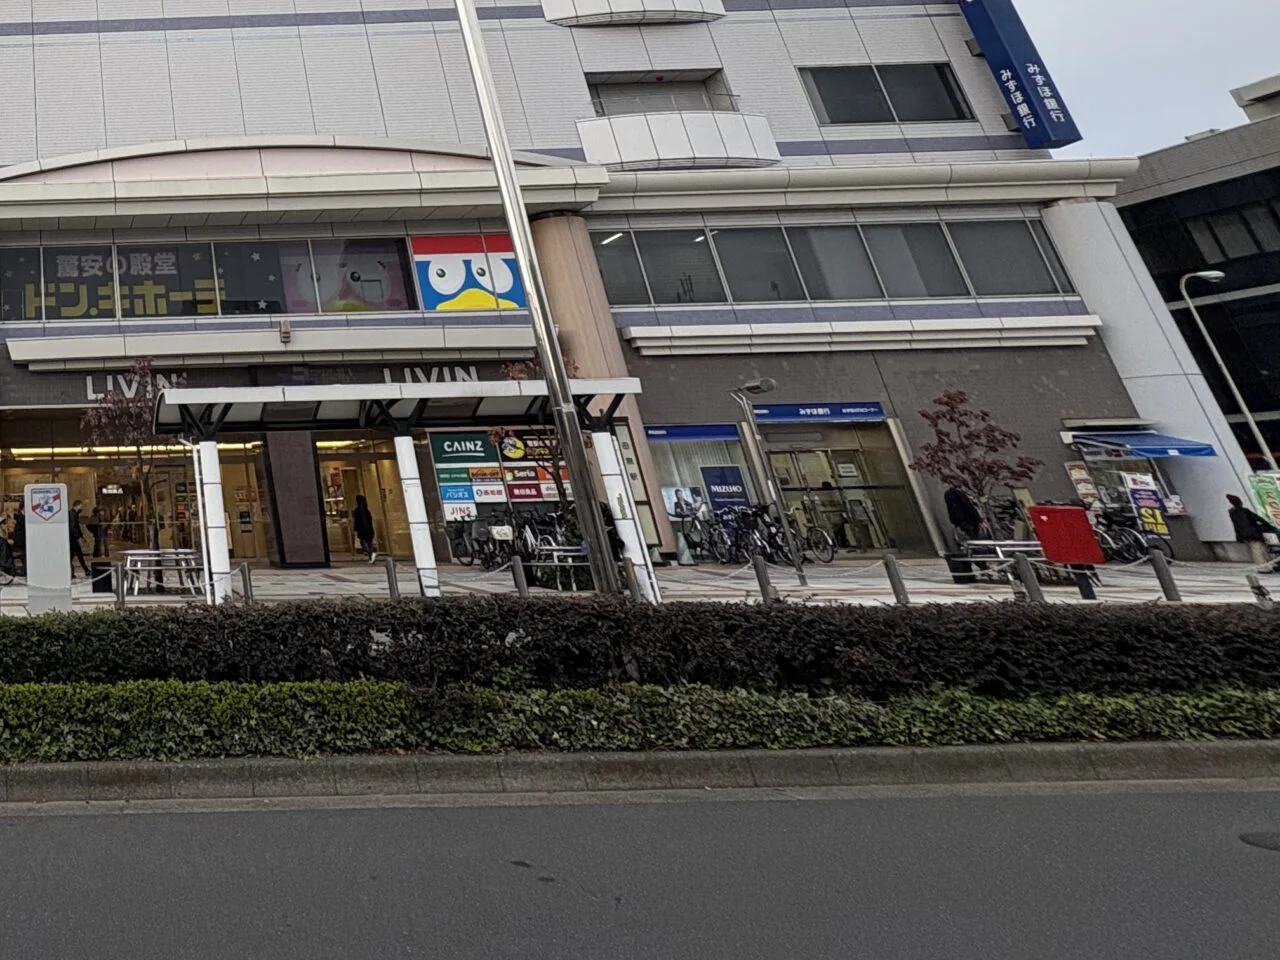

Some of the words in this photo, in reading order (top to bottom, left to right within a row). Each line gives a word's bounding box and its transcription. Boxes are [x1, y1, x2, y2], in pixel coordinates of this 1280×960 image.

[56, 252, 178, 278] 驚安の殿堂
[443, 441, 484, 452] CAINZ
[514, 469, 536, 478] Seria
[450, 506, 472, 516] JINS
